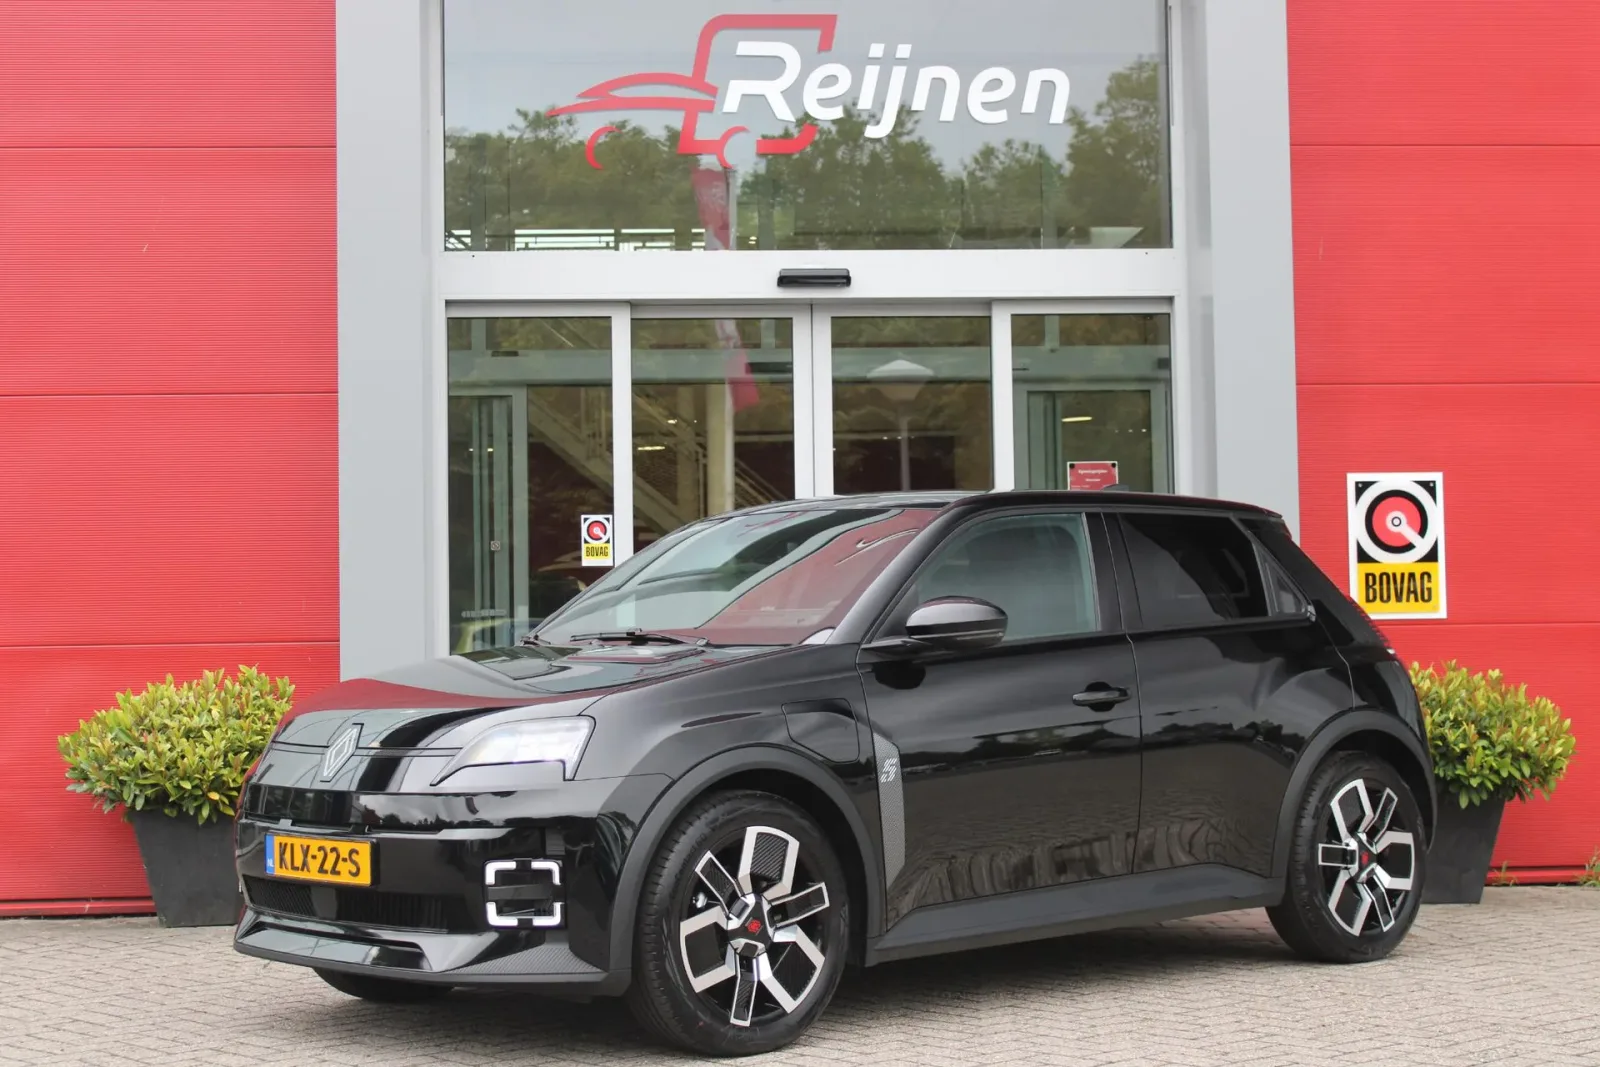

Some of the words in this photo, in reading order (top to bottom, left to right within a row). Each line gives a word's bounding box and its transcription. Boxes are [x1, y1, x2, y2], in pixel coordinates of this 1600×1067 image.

[722, 40, 1071, 138] Reijnen
[585, 546, 609, 557] BOVAG
[1364, 571, 1433, 604] BOVAG
[279, 842, 360, 877] KLX-22-S
